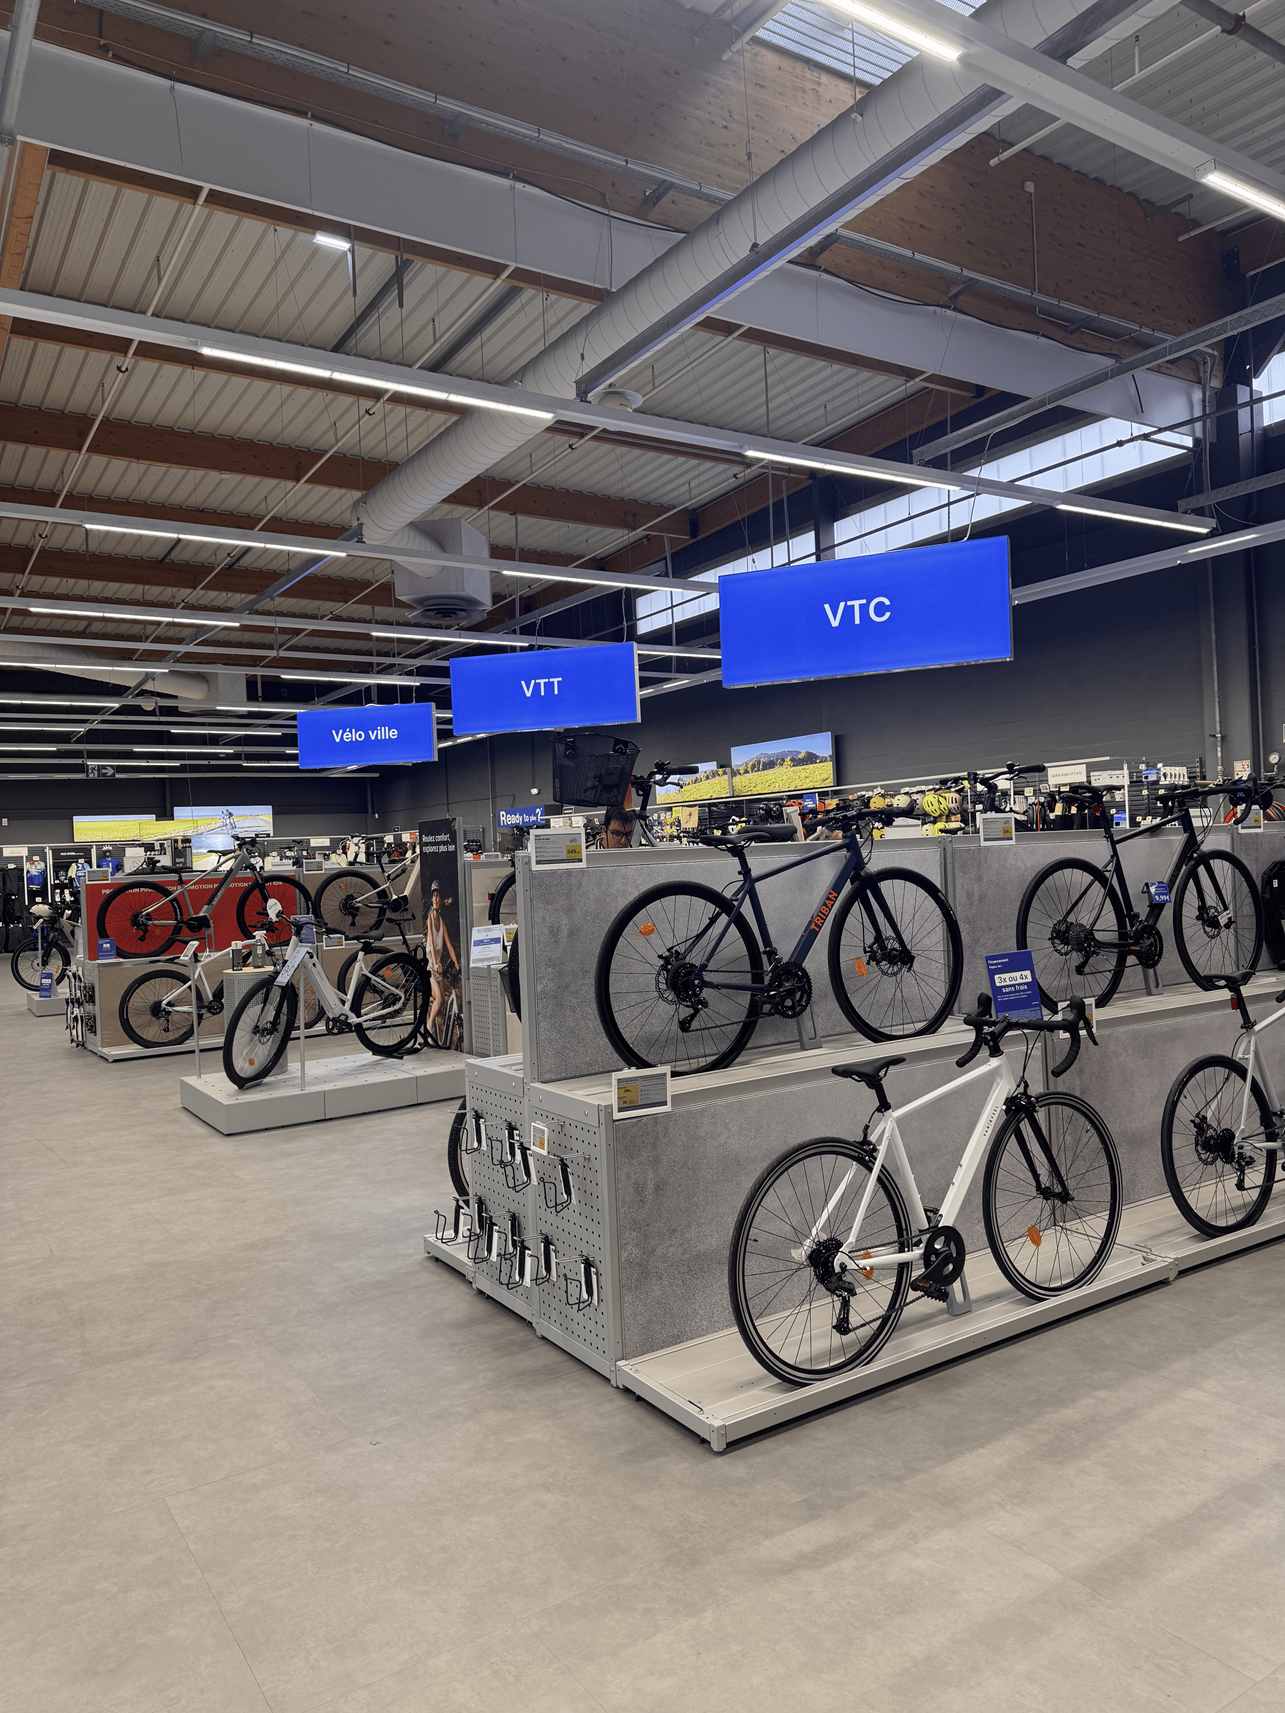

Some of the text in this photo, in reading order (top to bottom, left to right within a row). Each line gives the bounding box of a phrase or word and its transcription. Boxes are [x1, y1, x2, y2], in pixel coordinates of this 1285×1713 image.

[823, 596, 892, 628] VTC
[520, 677, 563, 698] VTT
[331, 726, 398, 744] Vélo ville
[500, 811, 523, 826] Ready
[523, 813, 530, 823] to
[422, 843, 456, 855] explorez plus loin
[810, 890, 838, 932] TRIBAN
[997, 973, 1029, 984] 3x ou 4x
